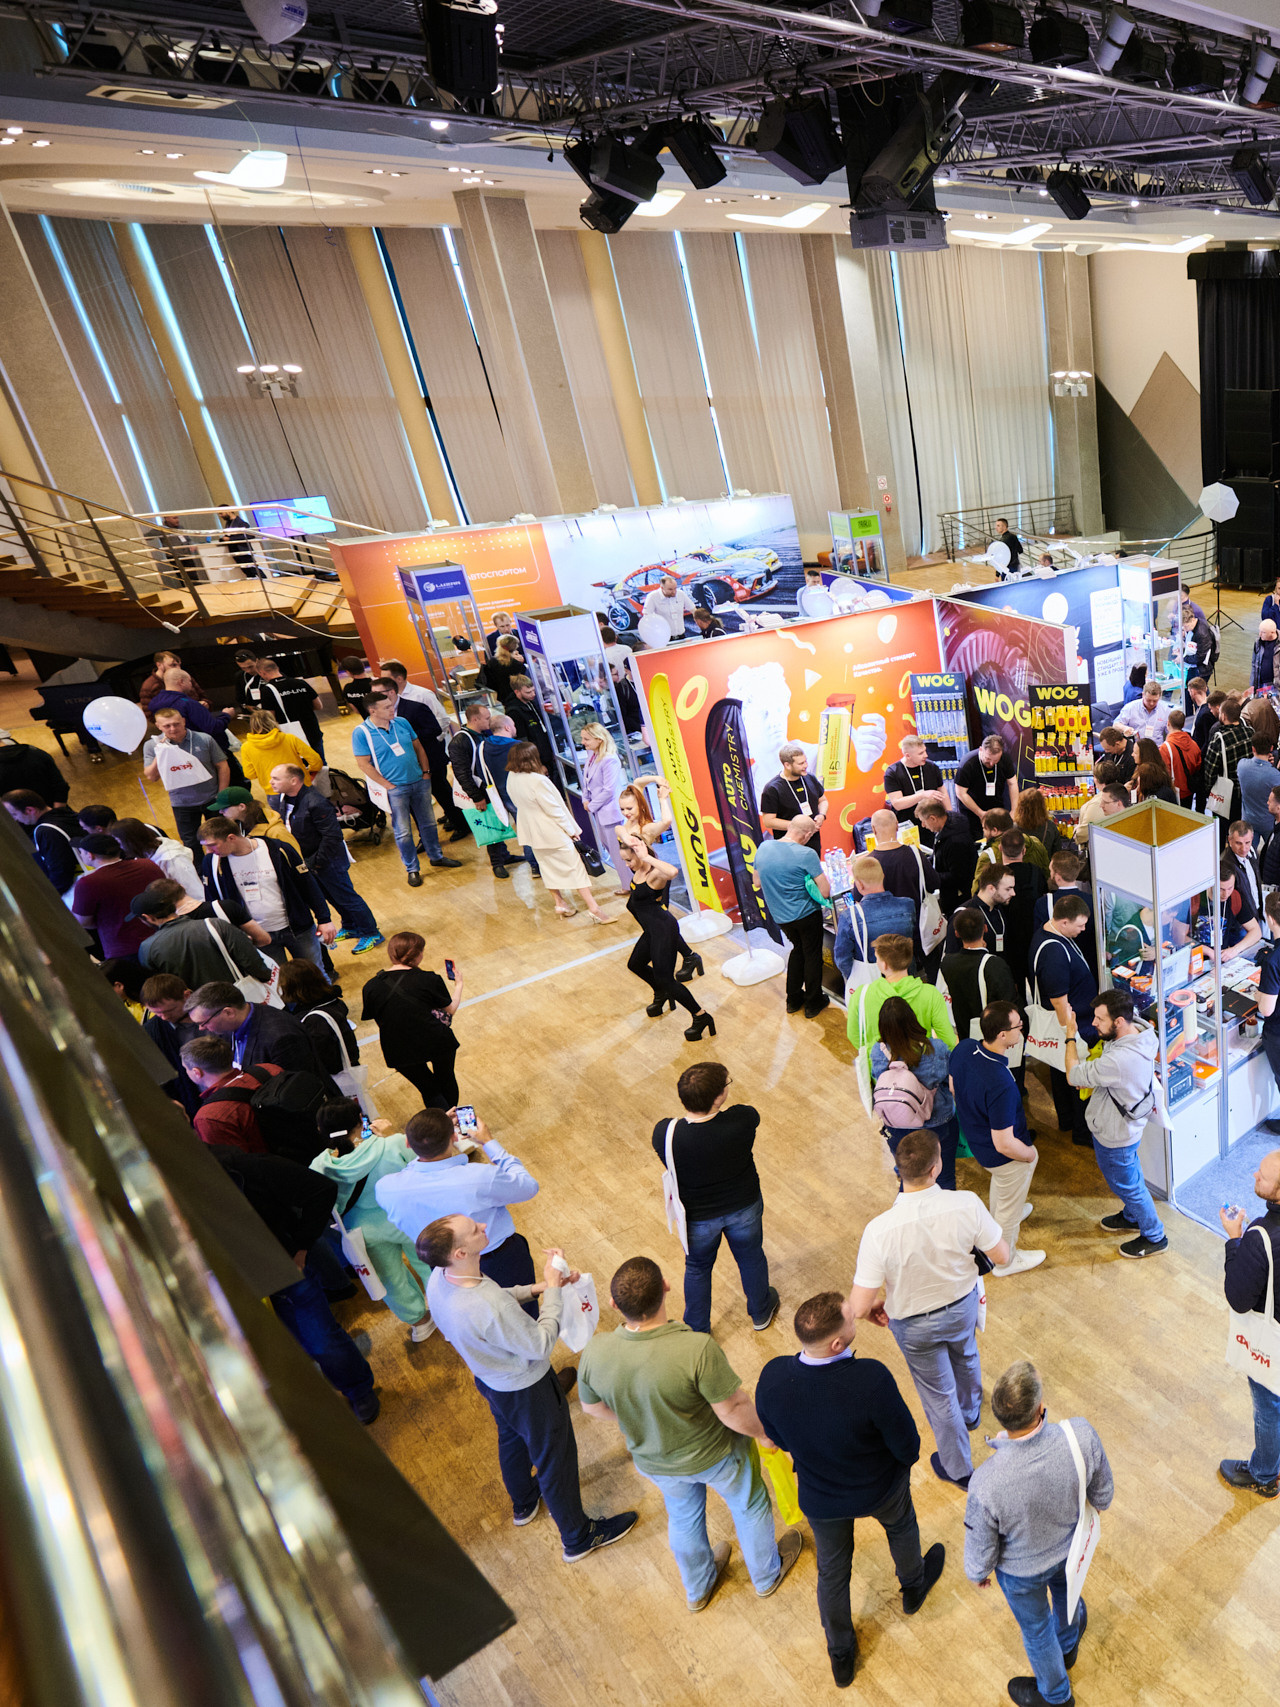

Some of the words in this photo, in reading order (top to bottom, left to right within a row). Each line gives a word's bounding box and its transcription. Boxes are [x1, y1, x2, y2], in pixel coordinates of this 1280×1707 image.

[916, 674, 955, 688] WOG
[1036, 686, 1079, 700] WOG
[974, 686, 1032, 728] WOG
[660, 696, 686, 784] CHEMISTRY
[821, 716, 829, 745] WOG
[665, 737, 681, 779] AUTO
[725, 722, 750, 812] CHEMISTRY
[721, 762, 738, 808] AUTO
[686, 805, 710, 888] WOG
